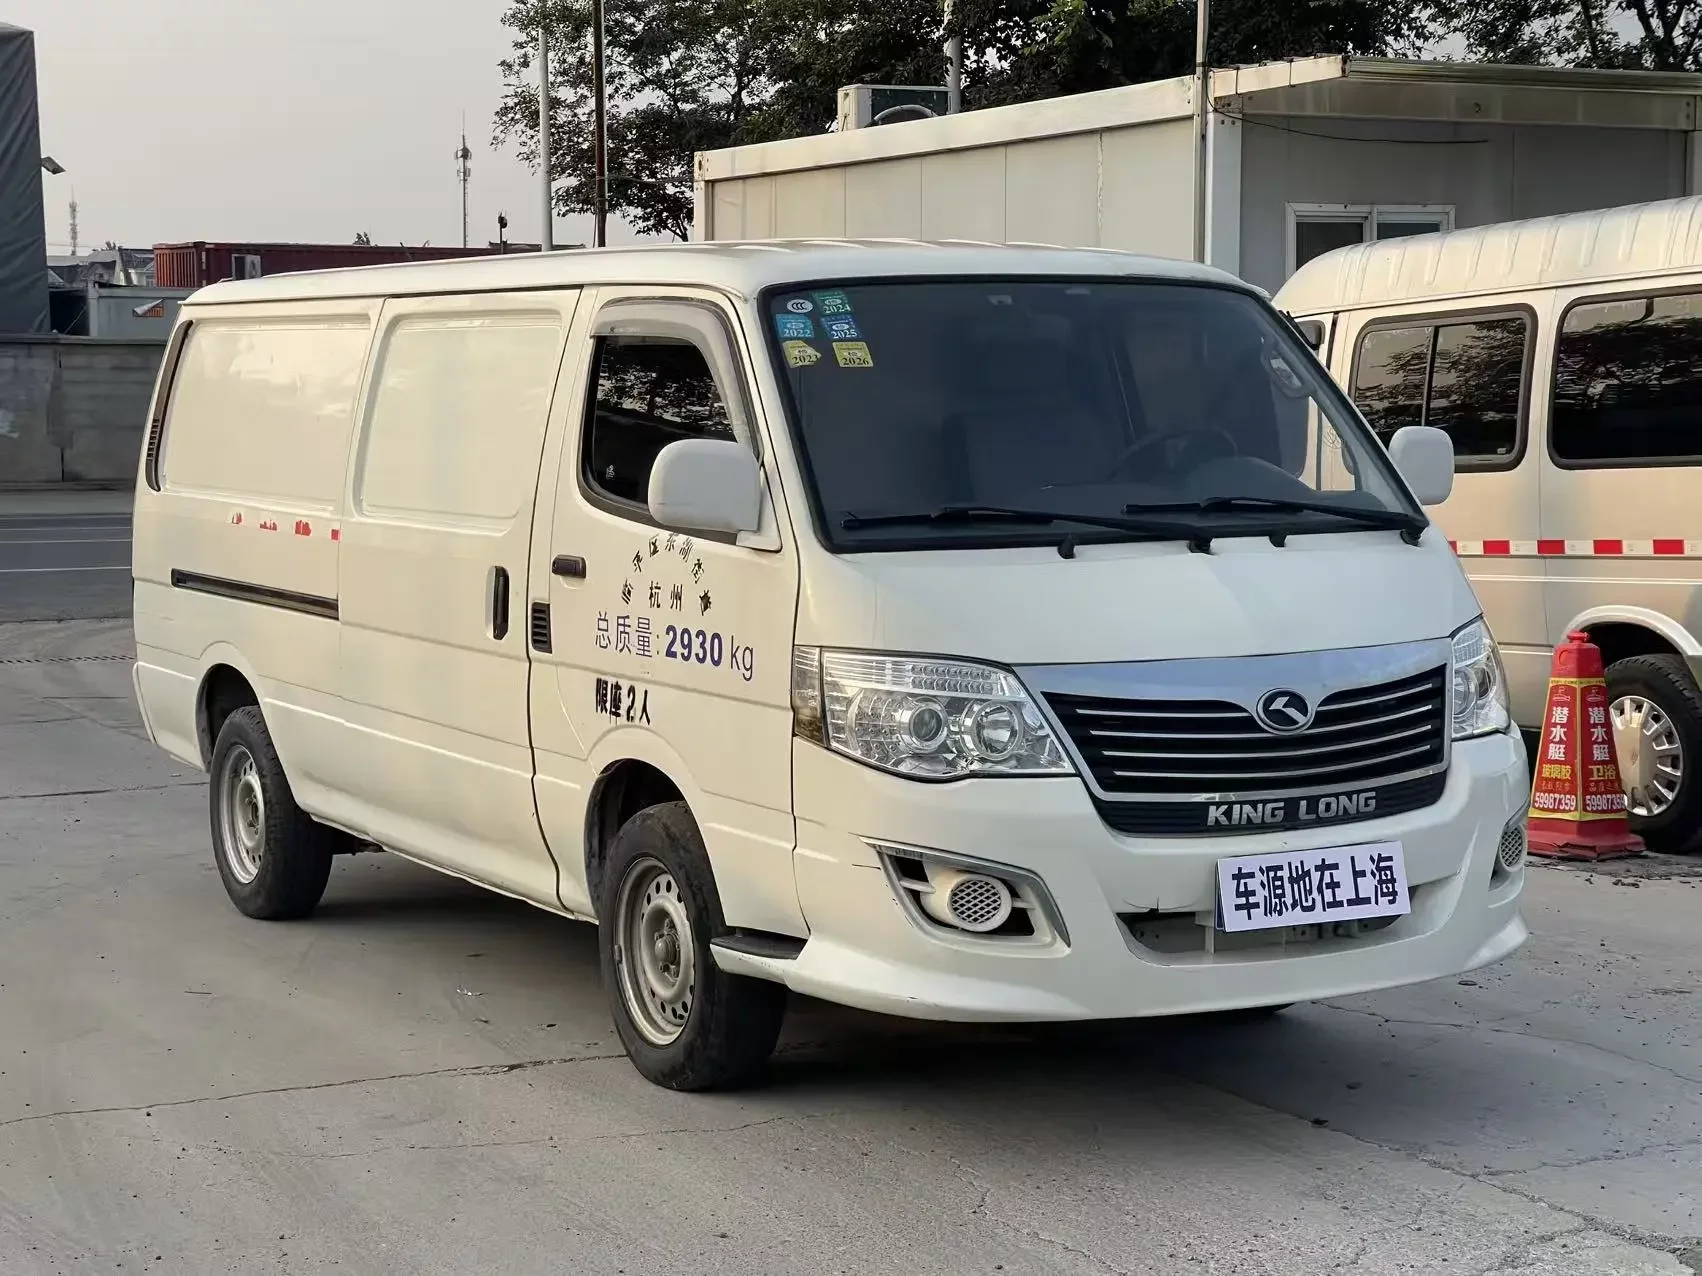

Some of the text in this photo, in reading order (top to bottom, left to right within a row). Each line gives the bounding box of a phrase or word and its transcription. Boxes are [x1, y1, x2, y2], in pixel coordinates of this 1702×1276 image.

[823, 304, 851, 313] 2024
[783, 328, 811, 337] 2022
[831, 329, 858, 339] 2025
[792, 354, 818, 365] 2023
[842, 357, 869, 366] 2026
[648, 580, 684, 611] 杭州
[1547, 706, 1569, 761] 潜水艇
[1588, 706, 1609, 761] 潜水艇
[1588, 764, 1616, 780] 卫浴
[1207, 792, 1376, 826] KING LONG
[1534, 792, 1576, 811] 59987359
[1231, 852, 1399, 921] 车源地在上海
